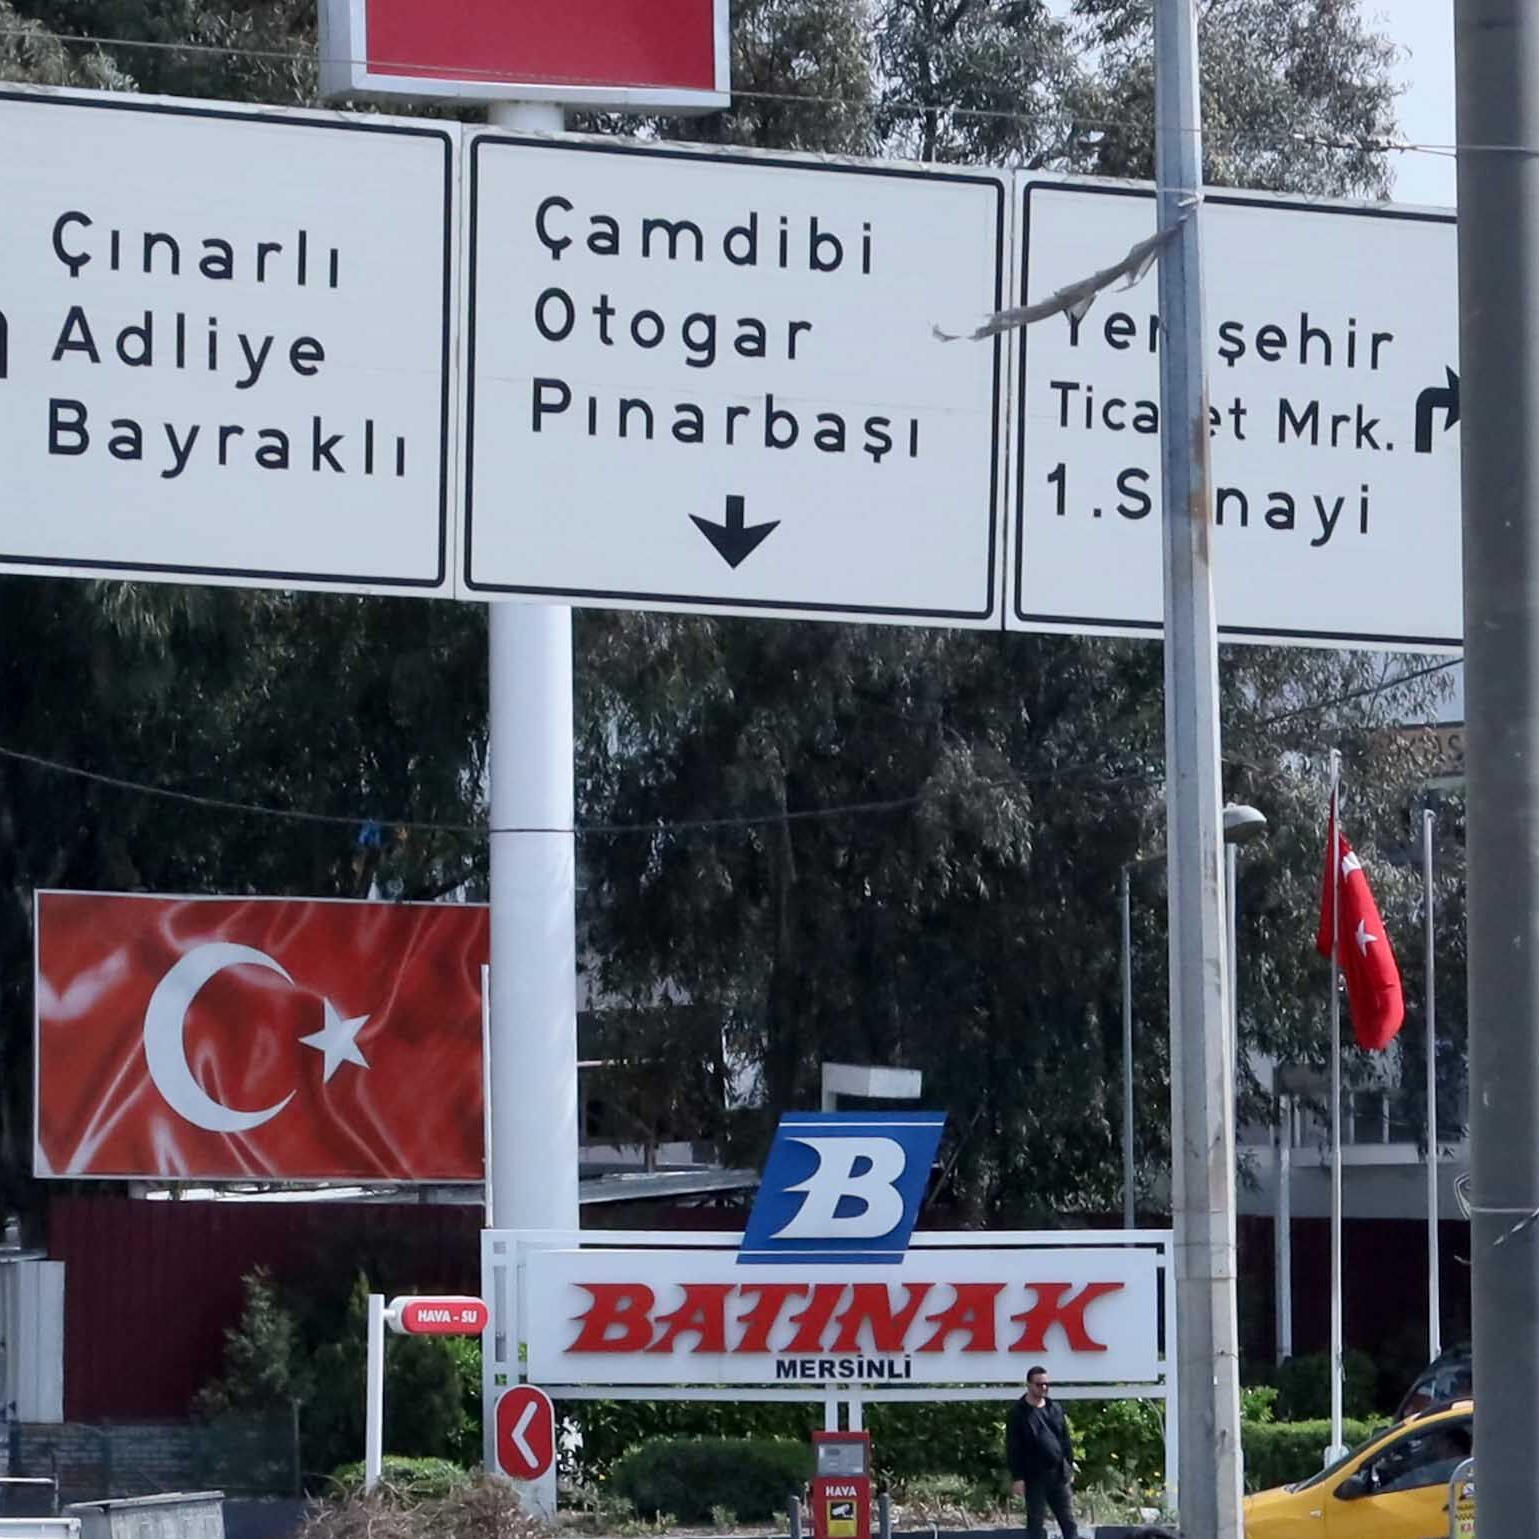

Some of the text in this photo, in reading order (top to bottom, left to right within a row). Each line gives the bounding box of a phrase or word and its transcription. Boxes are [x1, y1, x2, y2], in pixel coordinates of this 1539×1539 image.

[52, 210, 339, 288] Çınarlı
[535, 195, 872, 275] Çamdibi
[51, 305, 326, 390] Adliye
[535, 286, 813, 368] Otogar
[48, 398, 406, 480] Bayraklı
[532, 377, 919, 464] Pınarbaşı
[1278, 397, 1395, 451] Mrk.
[1047, 462, 1370, 548] 1.Snayi
[769, 1136, 906, 1239] B
[417, 1310, 451, 1323] HAVA
[461, 1310, 478, 1323] SU
[563, 1281, 1125, 1353] BATINAK
[776, 1354, 912, 1379] MERSİNLİ
[825, 1486, 857, 1497] HAVA
